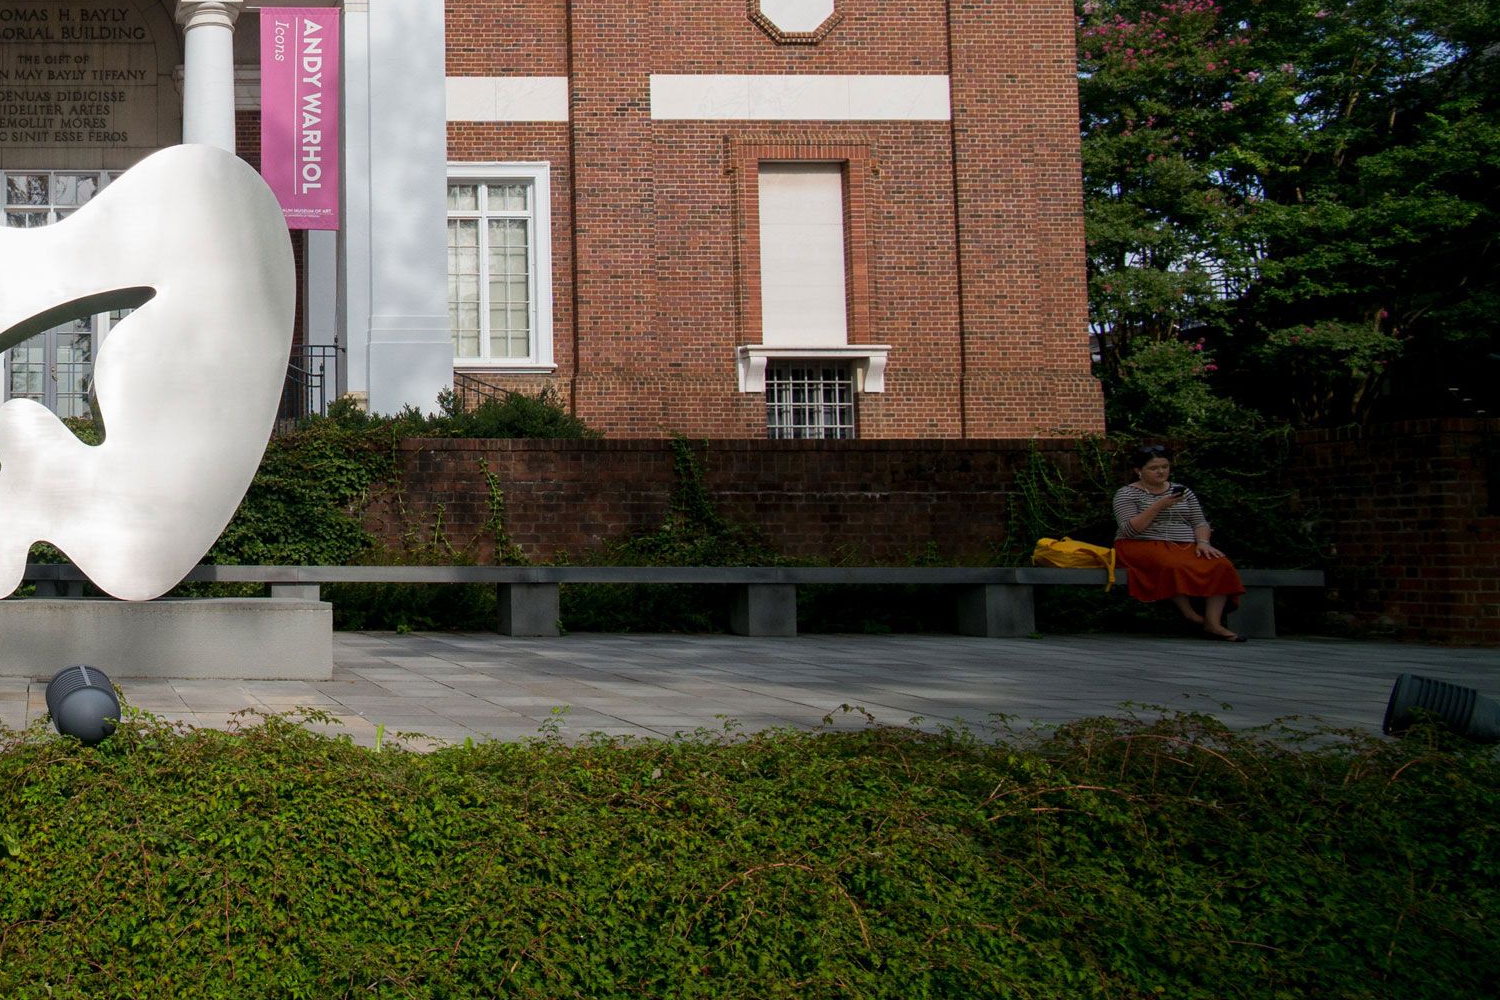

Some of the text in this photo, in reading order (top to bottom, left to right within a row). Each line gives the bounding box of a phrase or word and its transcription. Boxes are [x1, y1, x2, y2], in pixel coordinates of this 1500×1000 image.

[59, 9, 75, 21] H.
[81, 9, 129, 21] BAYLY
[61, 27, 146, 40] BUILDING
[275, 20, 290, 62] Icons
[302, 19, 323, 88] ANDY
[17, 55, 90, 64] THE GIFT OF
[15, 70, 42, 80] MAY
[48, 70, 87, 80] BAYLY
[92, 70, 147, 80] TIFFANY
[57, 91, 126, 101] DIDICISSE
[69, 105, 110, 115] ARTES
[0, 118, 107, 129] EMOLLIT MORES
[11, 132, 49, 142] SINIT
[54, 132, 84, 142] ESSE
[88, 132, 128, 142] FEROS
[302, 93, 321, 194] WARHOL
